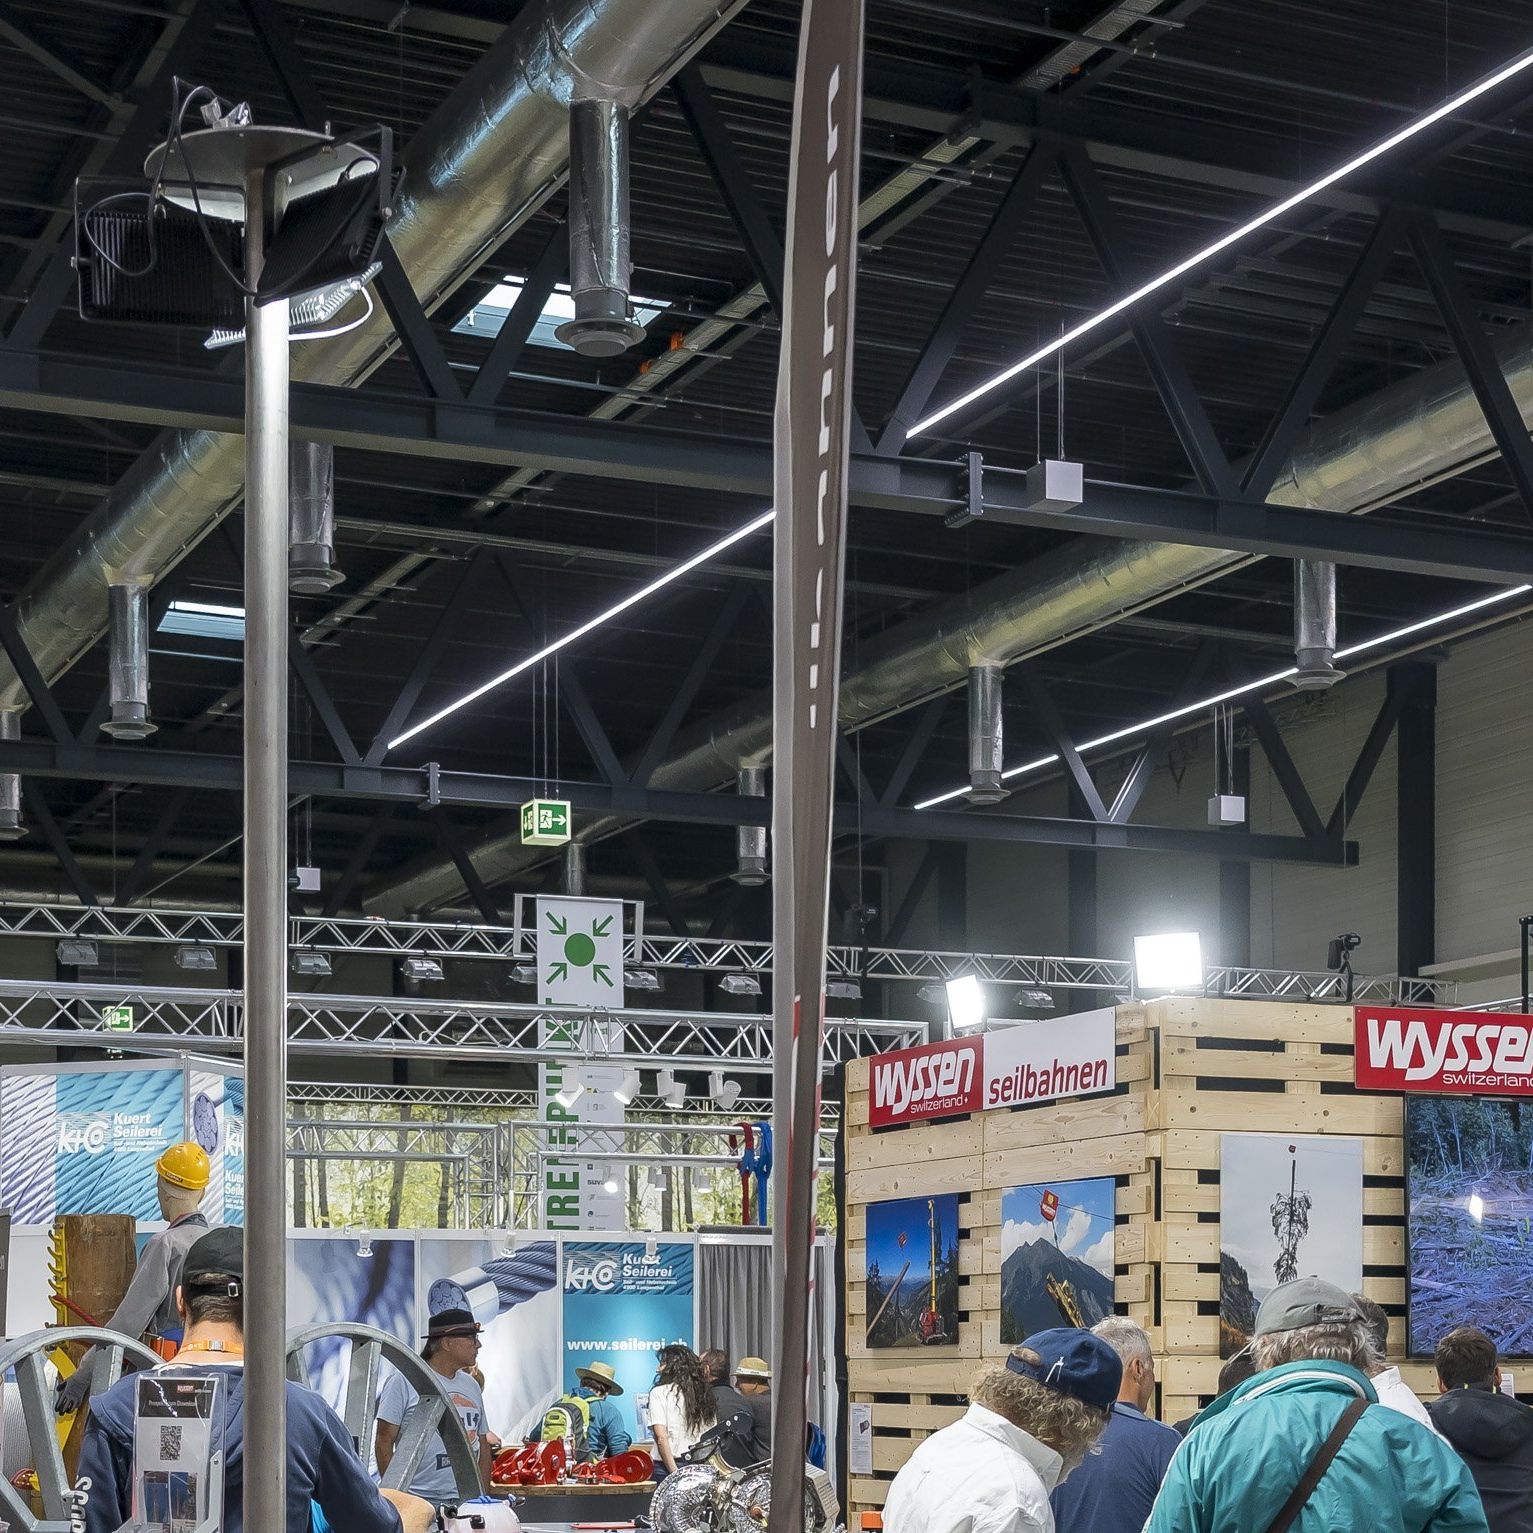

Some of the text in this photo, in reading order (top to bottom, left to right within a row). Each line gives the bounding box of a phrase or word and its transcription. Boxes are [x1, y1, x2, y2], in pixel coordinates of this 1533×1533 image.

[988, 1058, 1108, 1105] seilbahnen
[910, 1096, 964, 1114] switzerland
[113, 1113, 152, 1124] Kuert
[113, 1125, 163, 1138] Seilerei
[623, 1266, 673, 1277] Seilerei
